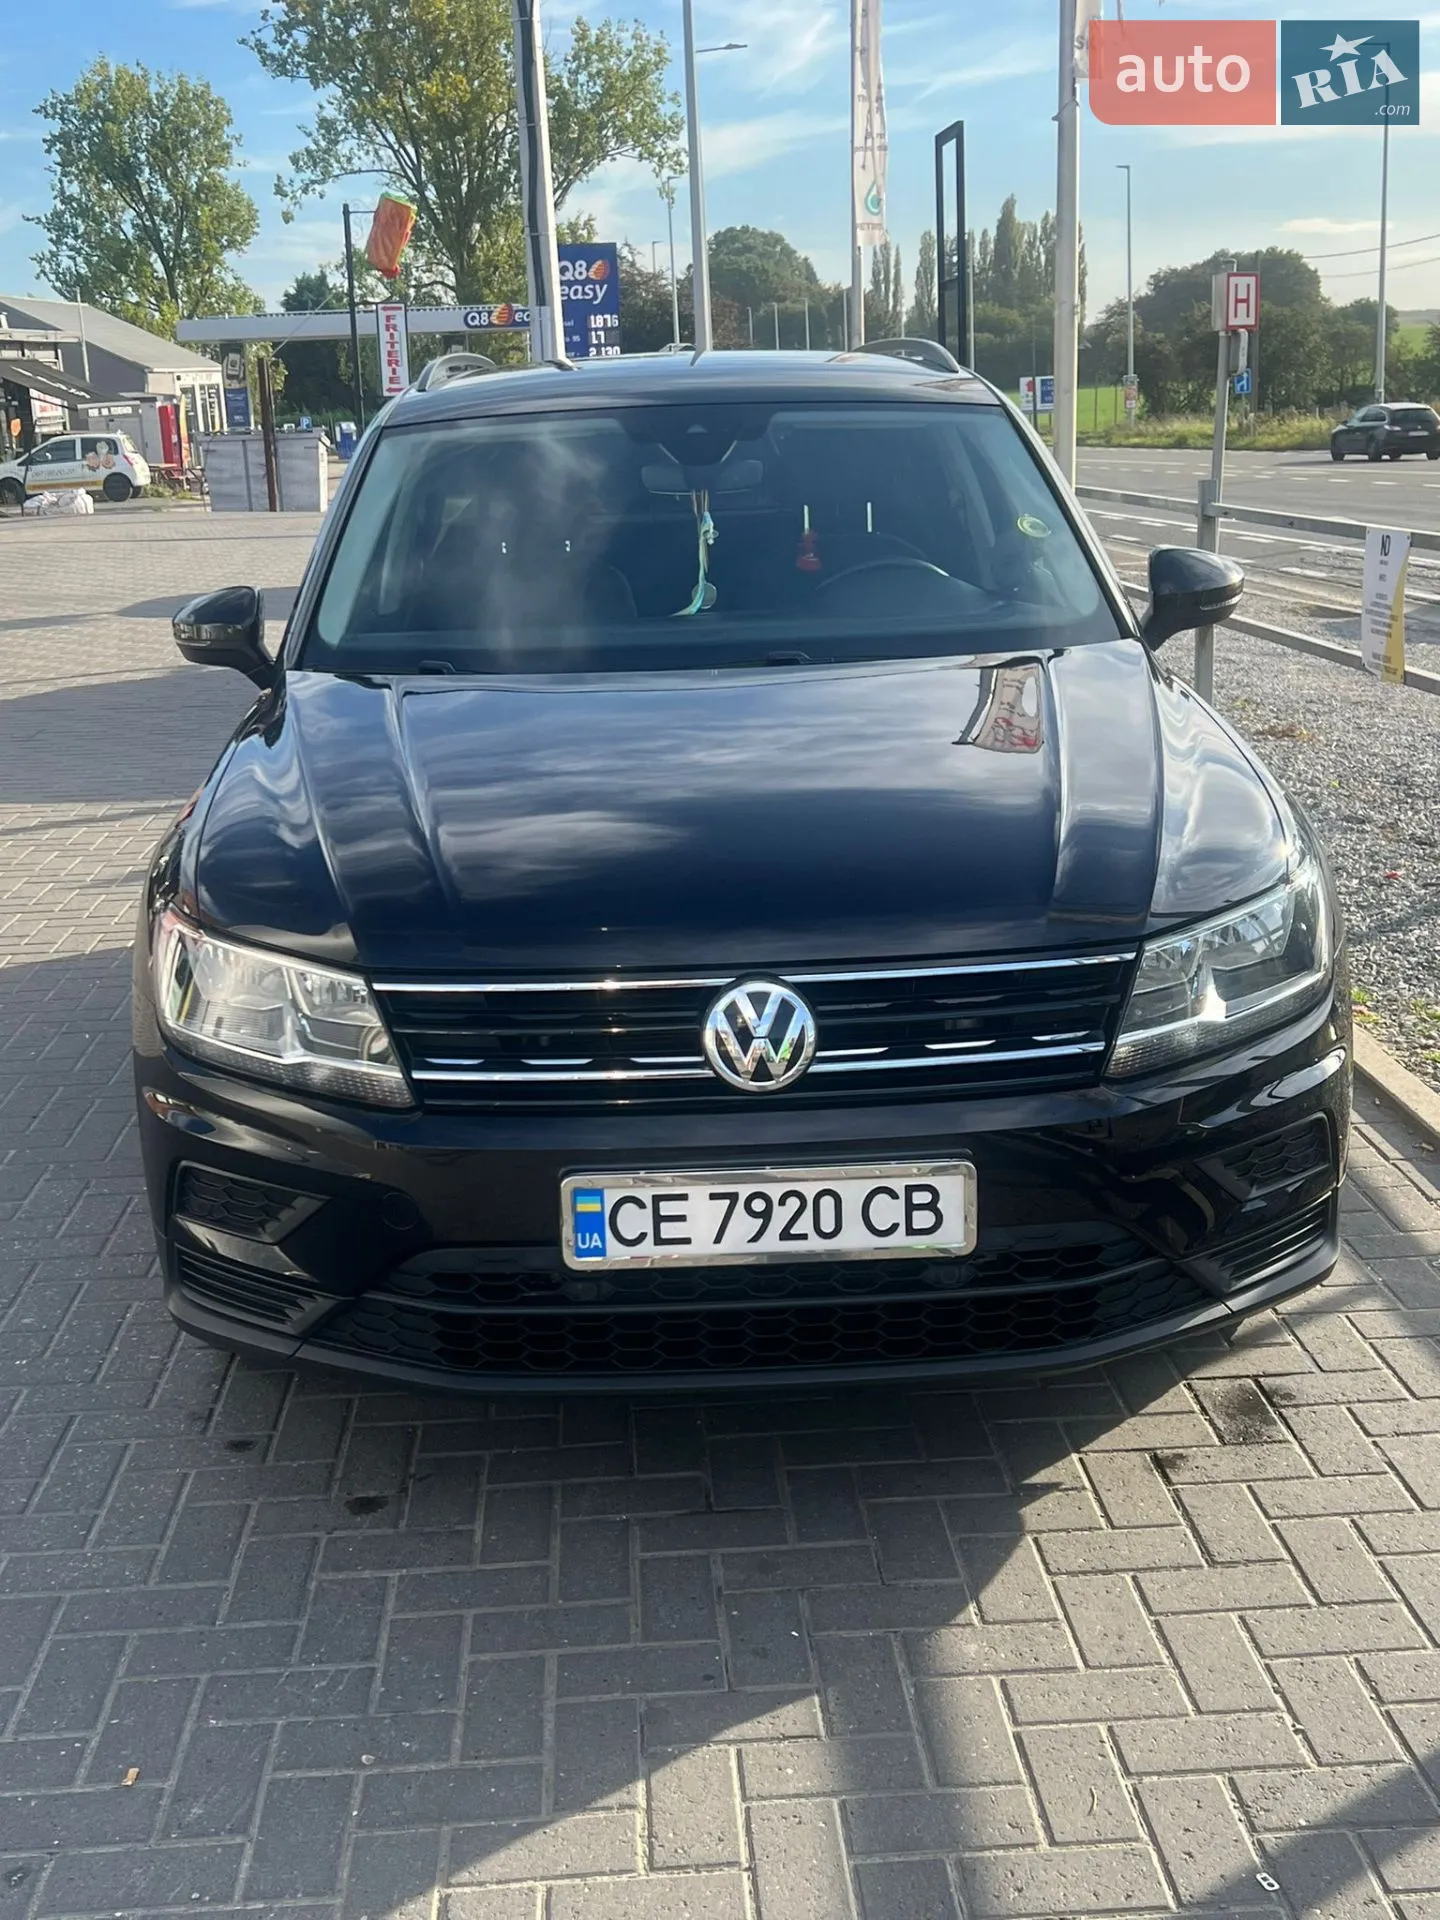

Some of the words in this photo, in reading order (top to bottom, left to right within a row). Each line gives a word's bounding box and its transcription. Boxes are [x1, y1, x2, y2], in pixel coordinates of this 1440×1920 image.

[559, 260, 587, 281] Q8
[560, 284, 608, 304] easy
[1234, 283, 1250, 319] H
[467, 311, 489, 326] Q8
[385, 314, 402, 385] FRITERIE
[608, 1193, 692, 1248] CE
[708, 1187, 843, 1245] 7920
[861, 1183, 944, 1238] CB
[577, 1232, 603, 1249] UA
